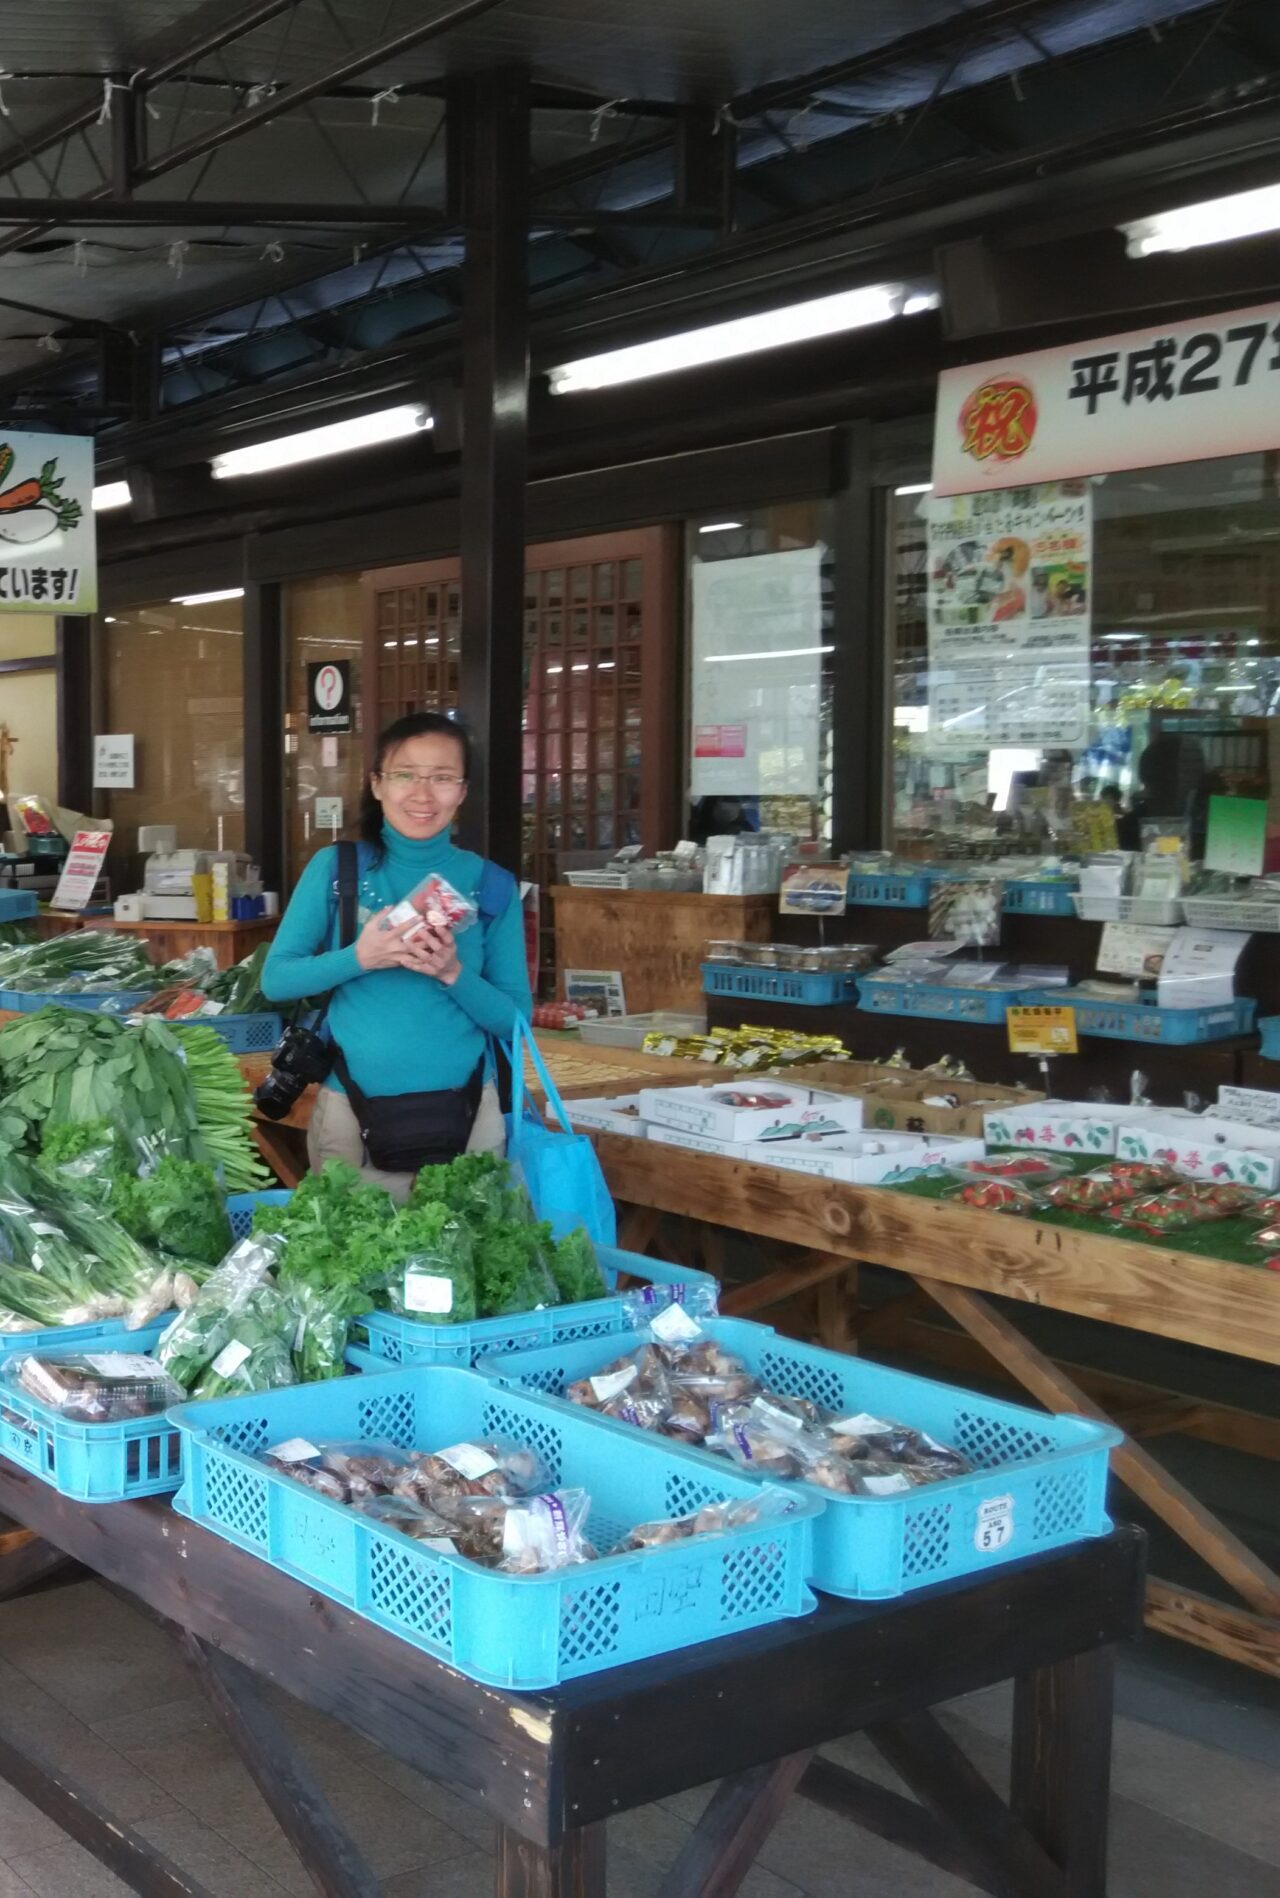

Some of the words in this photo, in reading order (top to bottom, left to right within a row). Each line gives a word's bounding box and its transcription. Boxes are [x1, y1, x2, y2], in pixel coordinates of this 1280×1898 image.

[1069, 321, 1280, 415] 平成27
[961, 383, 1035, 460] 祝
[983, 1502, 1008, 1515] ROUTE
